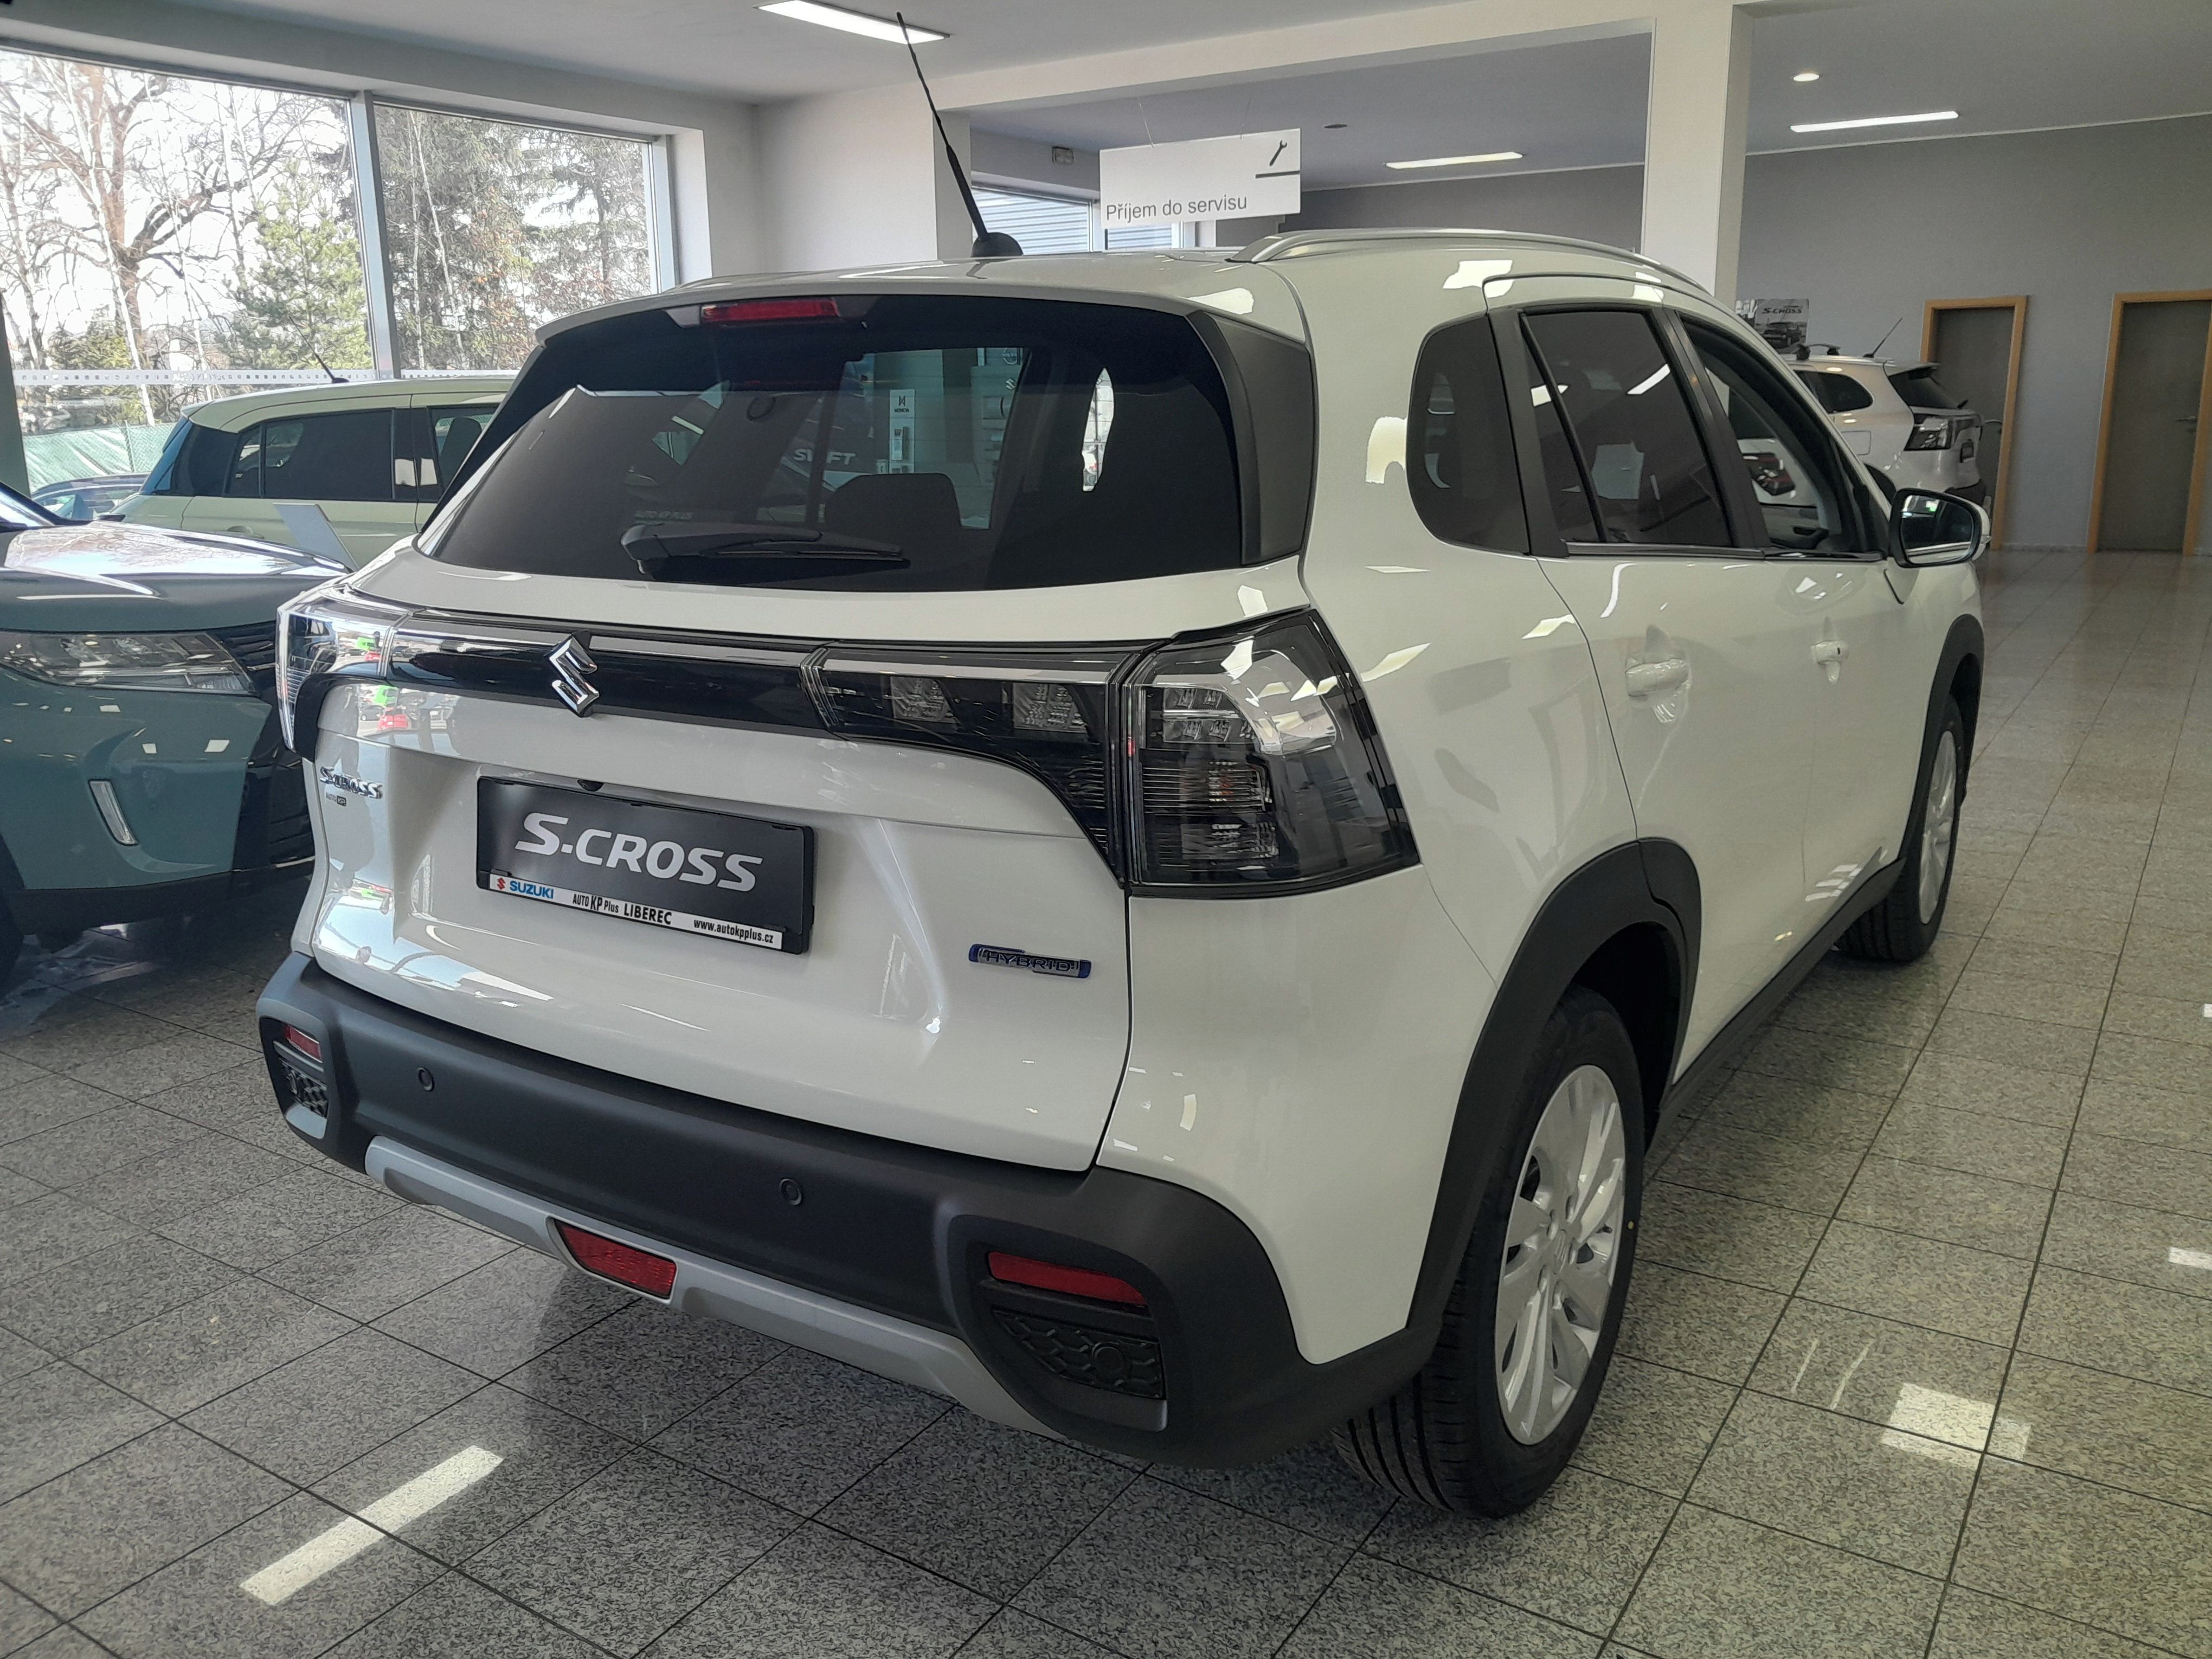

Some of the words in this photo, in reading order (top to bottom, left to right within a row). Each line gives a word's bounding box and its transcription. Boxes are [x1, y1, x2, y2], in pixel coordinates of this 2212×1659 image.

[1107, 202, 1156, 223] Příjem
[1162, 199, 1182, 216] do
[1188, 194, 1247, 214] servisu
[510, 880, 554, 899] SUZUKI
[573, 893, 589, 907] AUTO
[590, 895, 603, 911] KP
[604, 900, 619, 913] Plus
[624, 903, 672, 925] LIBEREC
[694, 919, 774, 943] www.autokpplus.cz
[986, 951, 1071, 972] HYBRID
